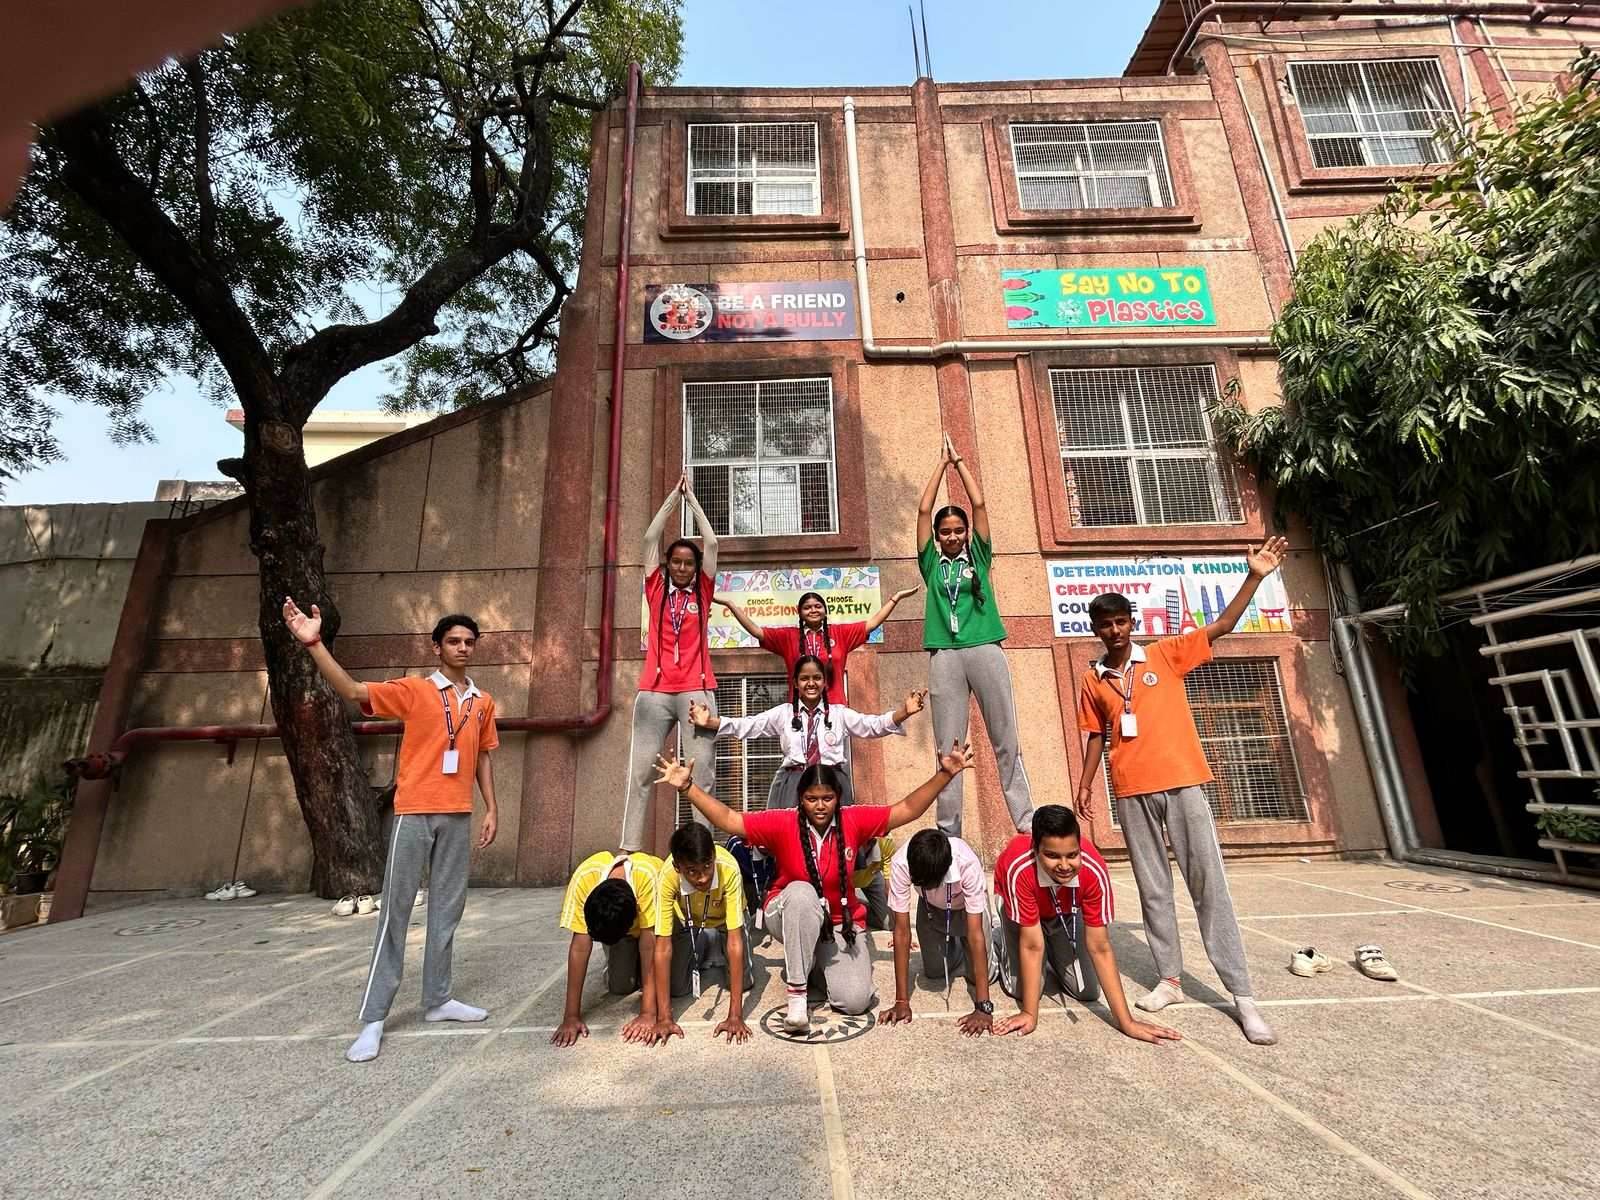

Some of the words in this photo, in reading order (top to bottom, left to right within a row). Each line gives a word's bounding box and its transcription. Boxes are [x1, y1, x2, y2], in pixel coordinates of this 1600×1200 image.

[1060, 273, 1109, 295] Say
[1117, 272, 1155, 295] No
[1160, 272, 1201, 294] To
[717, 296, 745, 309] BE
[753, 297, 764, 308] A
[771, 293, 846, 308] FRIEND
[1087, 299, 1206, 322] Plastics
[717, 314, 757, 328] NOT
[765, 314, 776, 327] A
[784, 312, 846, 327] BULLY
[1053, 563, 1186, 578] DETERMINATION
[1192, 562, 1249, 575] KINDN
[1055, 583, 1151, 596] CREATIVITY
[722, 605, 799, 617] CPASSION
[827, 602, 872, 615] PATHY
[1058, 601, 1139, 615] COUE
[1060, 619, 1142, 633] EQUY
